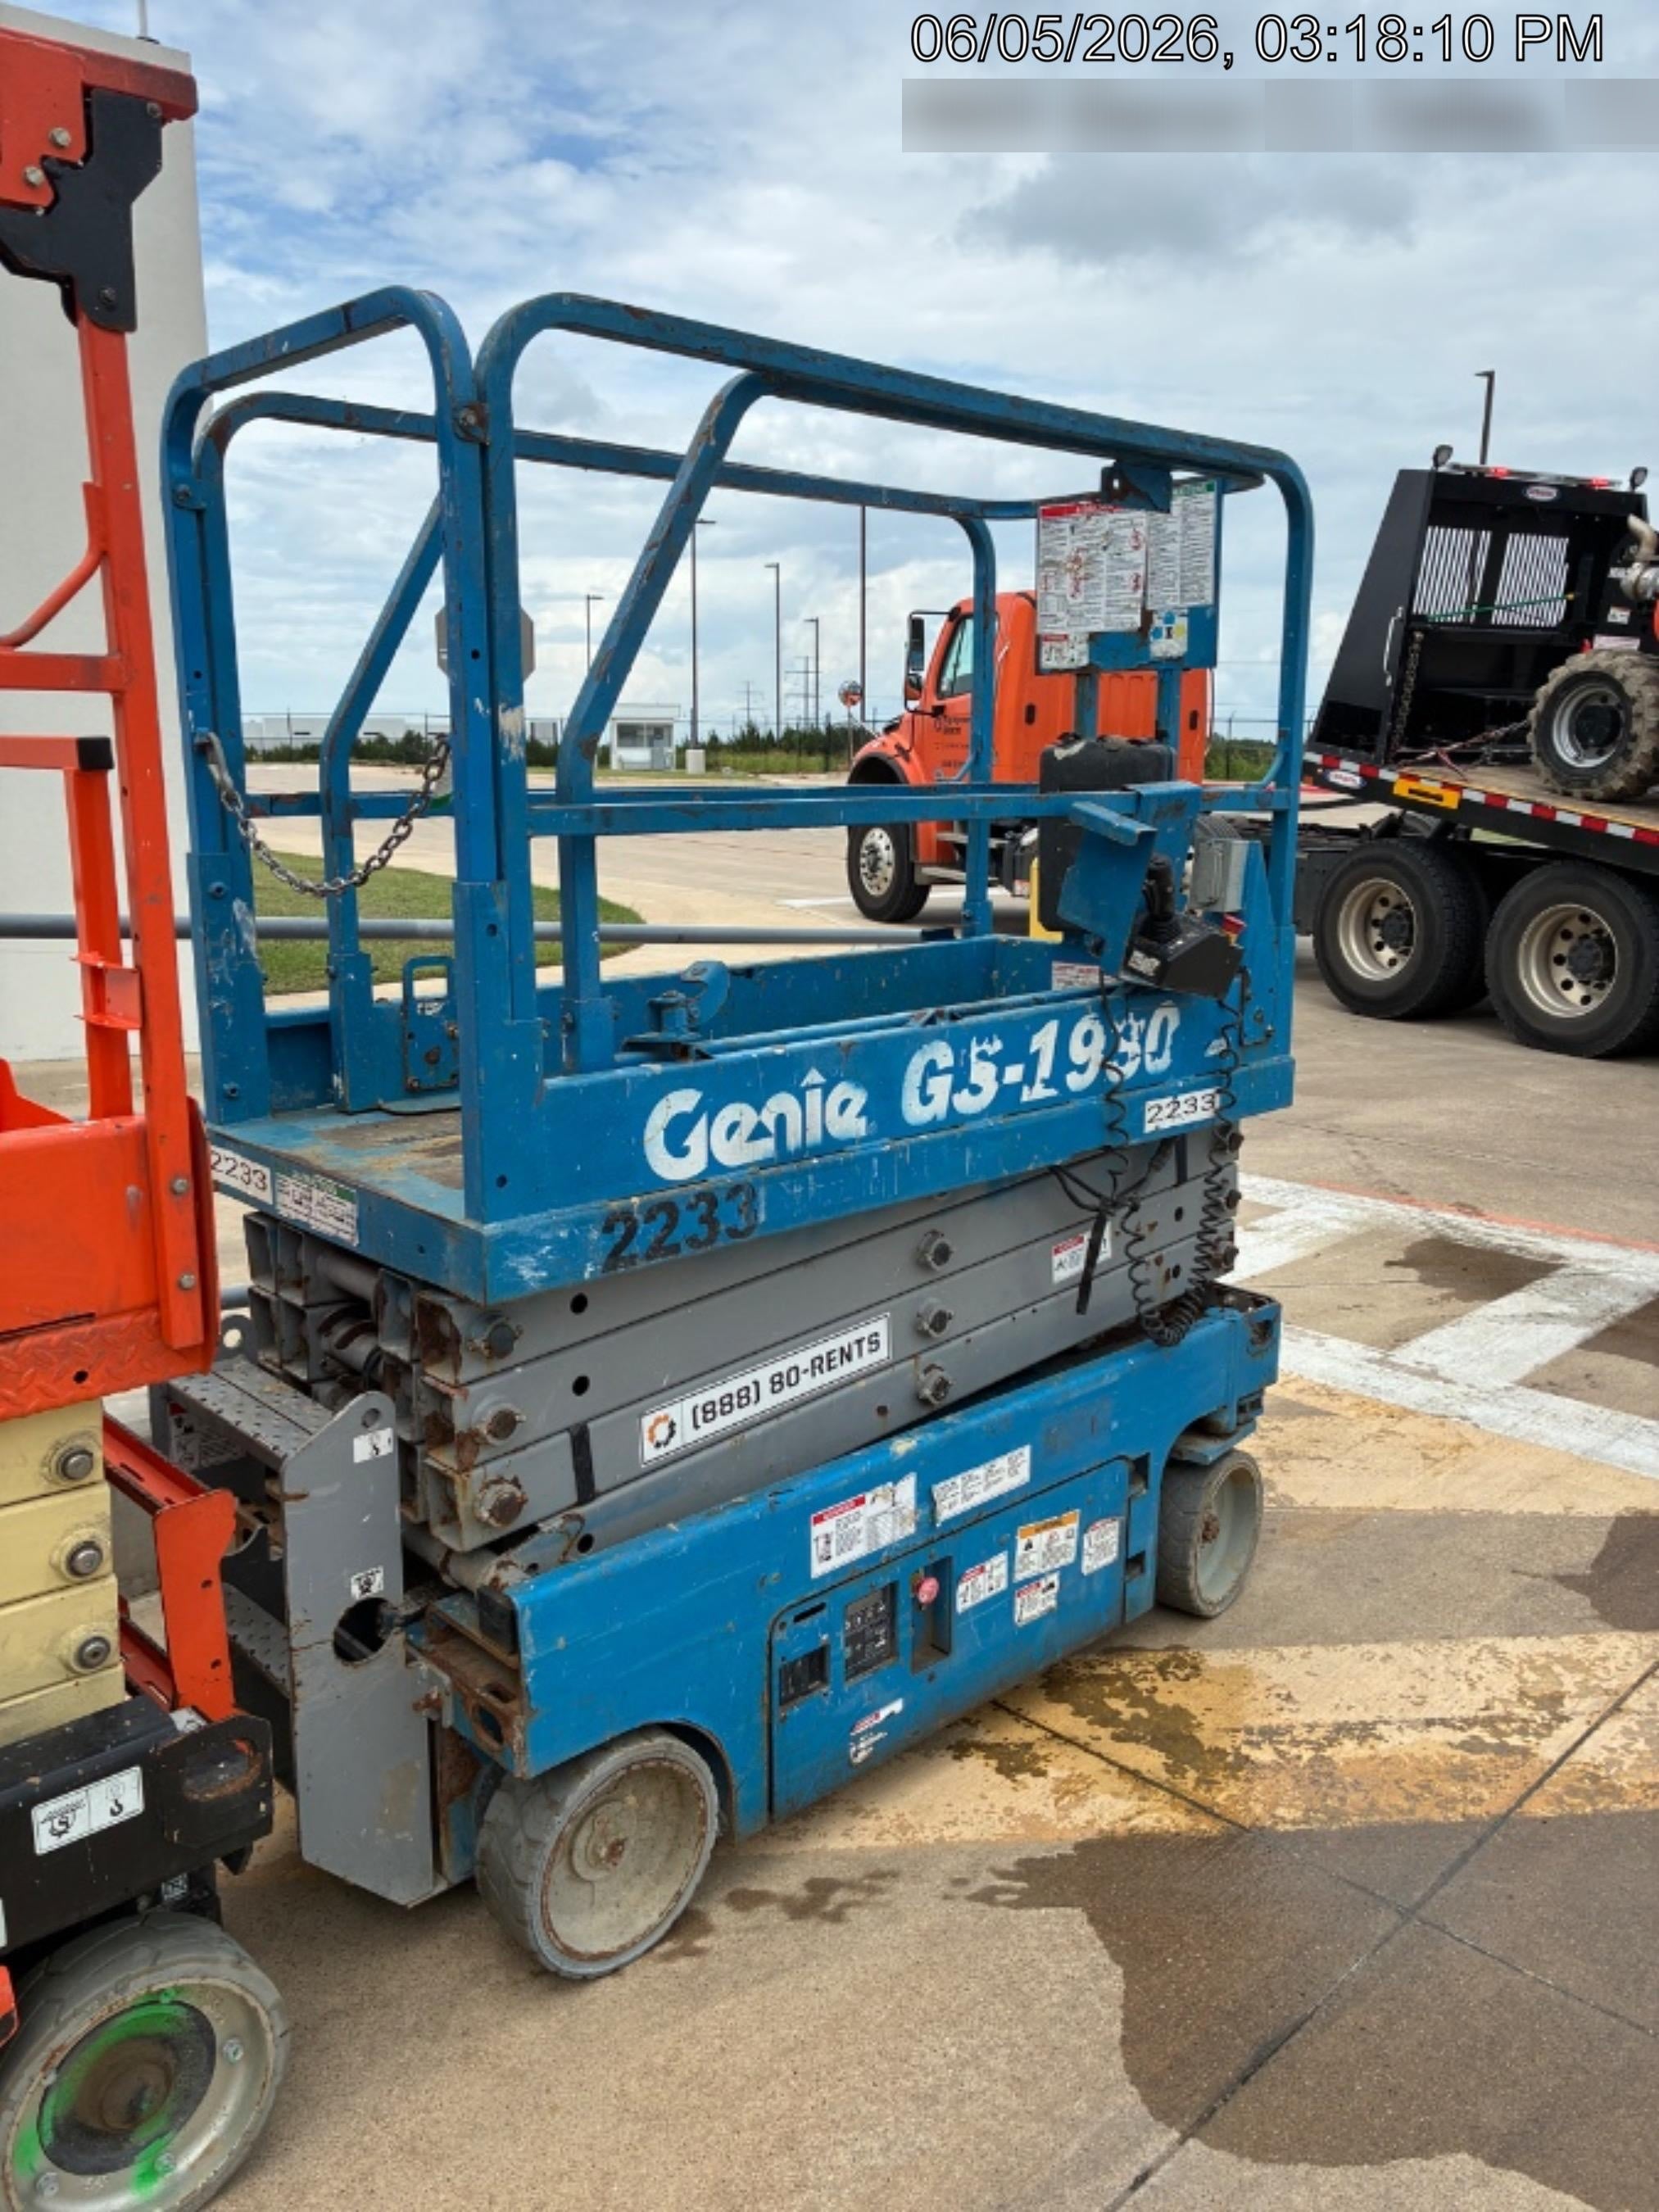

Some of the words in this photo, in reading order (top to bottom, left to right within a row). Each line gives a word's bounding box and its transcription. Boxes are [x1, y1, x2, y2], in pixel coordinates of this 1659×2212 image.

[1147, 1093, 1216, 1124] 2233
[211, 1149, 268, 1192] 2233
[601, 1182, 759, 1274] 2233
[691, 1380, 760, 1430] (888)
[769, 1330, 882, 1395] 80-RENTS
